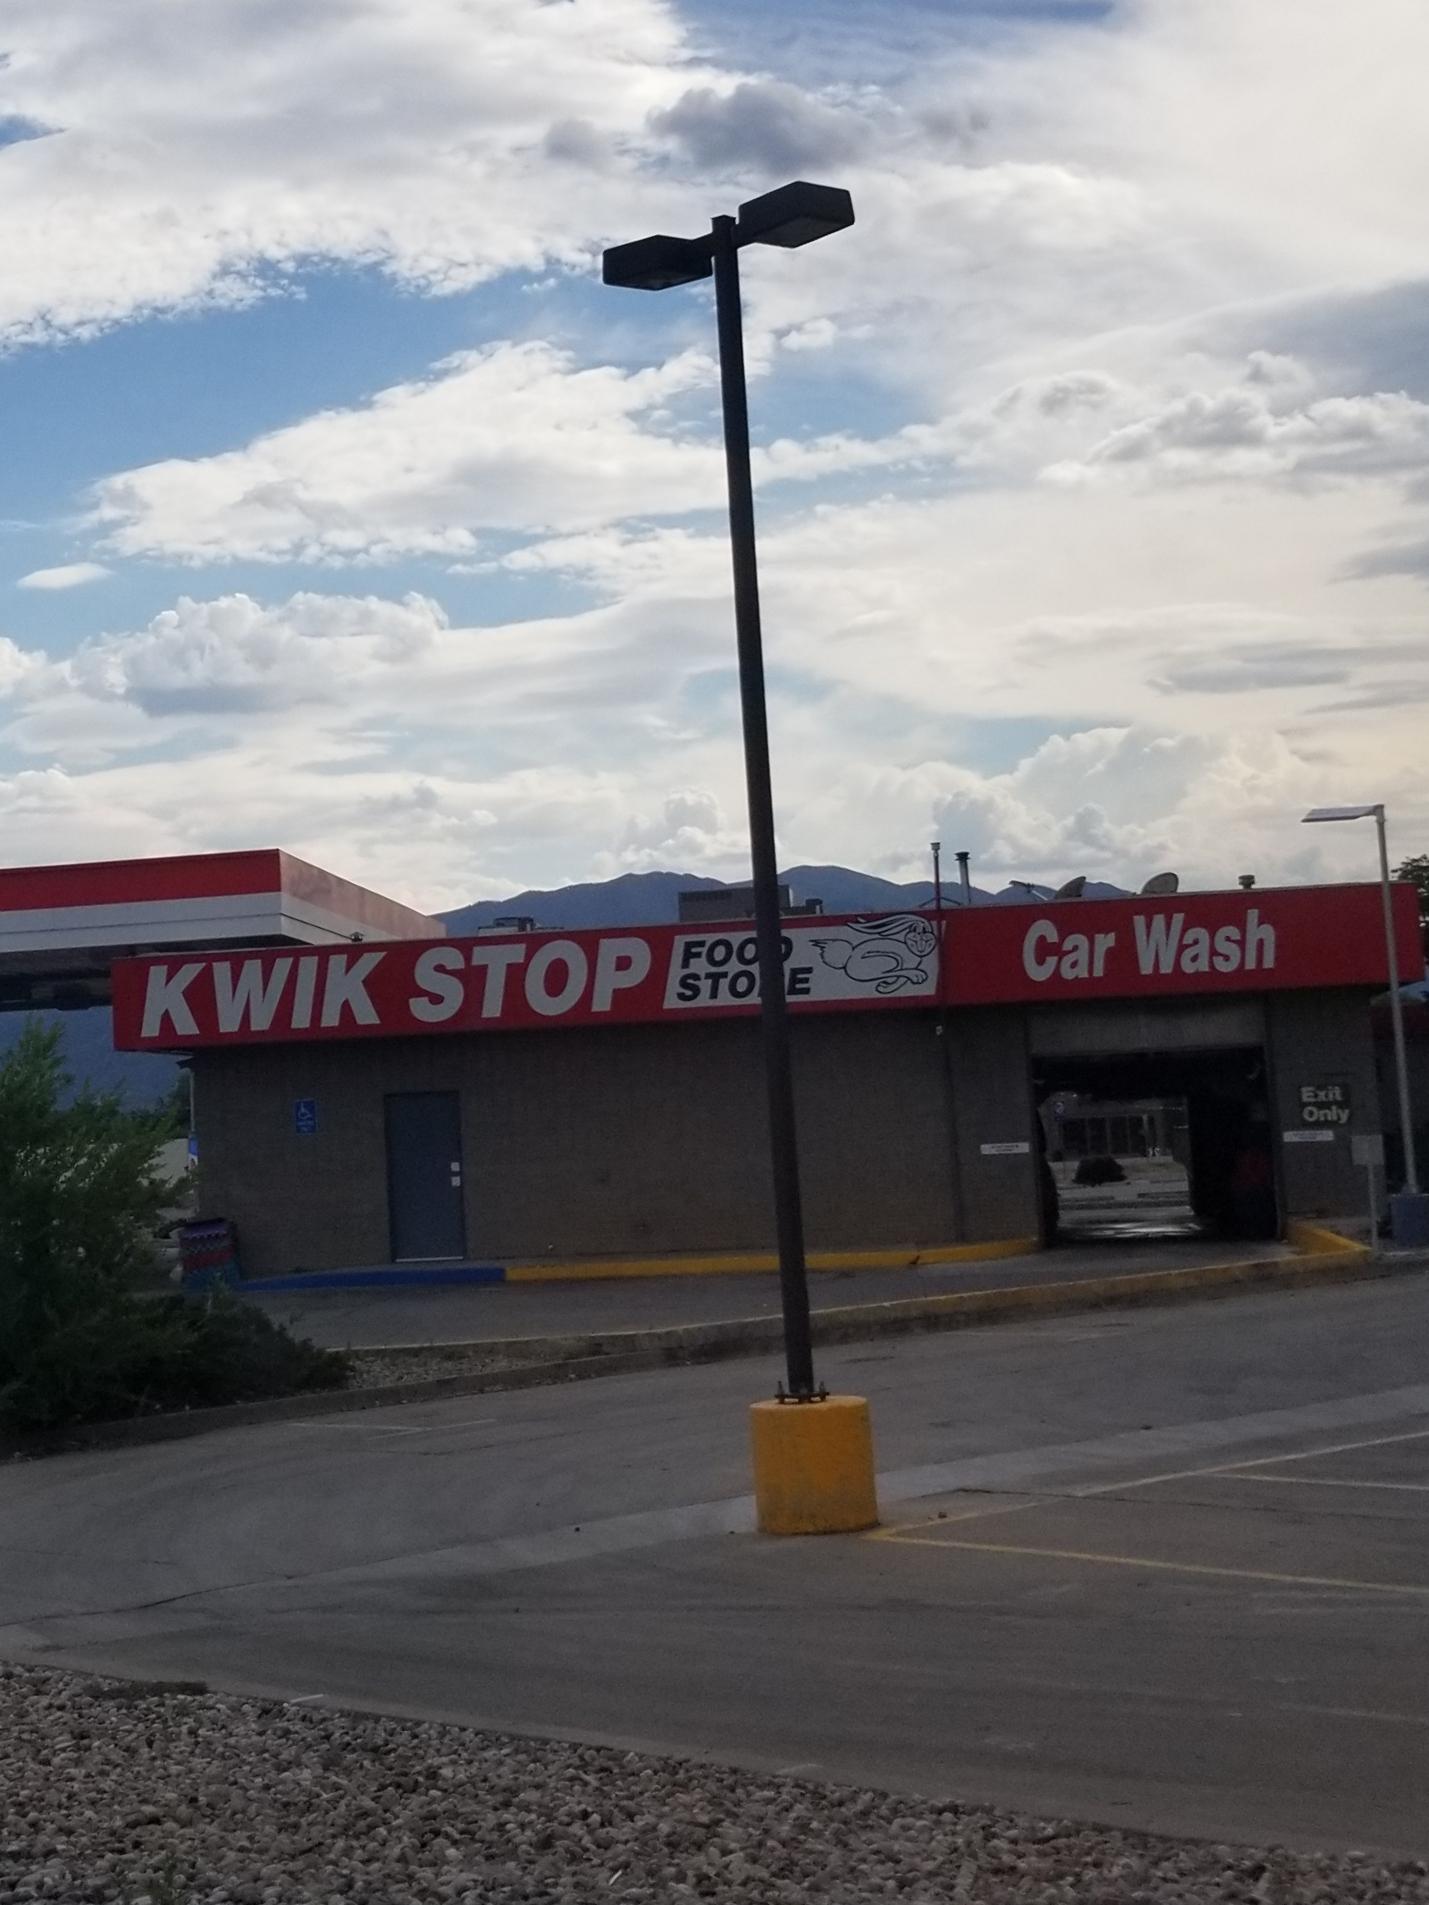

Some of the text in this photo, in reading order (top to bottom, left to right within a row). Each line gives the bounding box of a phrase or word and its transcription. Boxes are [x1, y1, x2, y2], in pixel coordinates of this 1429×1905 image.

[1022, 909, 1276, 982] Car Wash
[141, 938, 651, 1037] KWIK STOP
[676, 967, 813, 1001] STOE
[1301, 1086, 1342, 1102] Exit
[1303, 1106, 1349, 1124] Only
